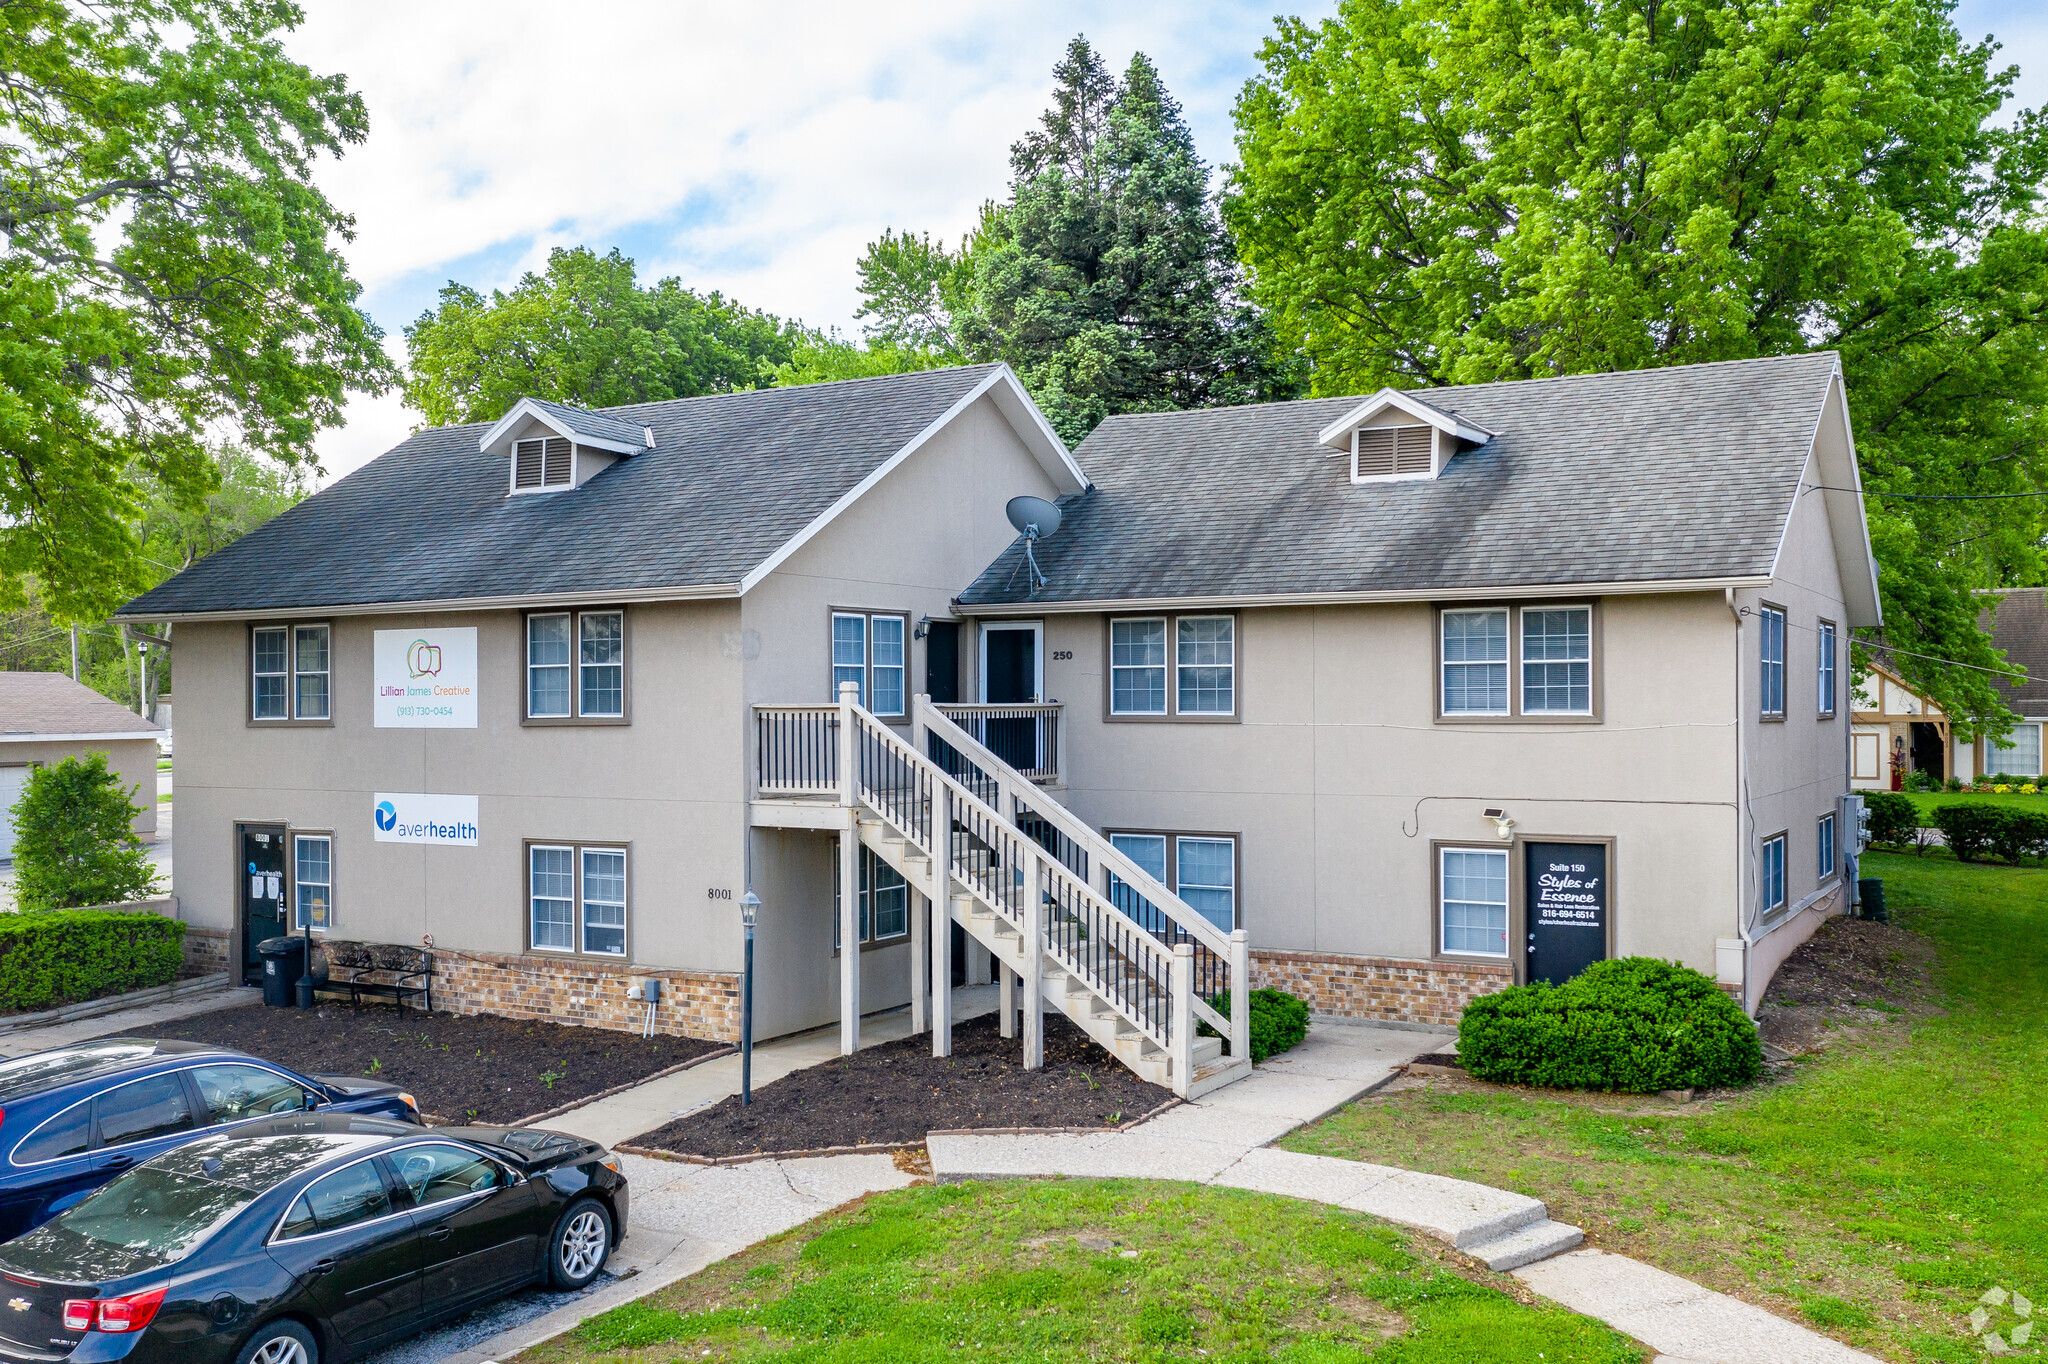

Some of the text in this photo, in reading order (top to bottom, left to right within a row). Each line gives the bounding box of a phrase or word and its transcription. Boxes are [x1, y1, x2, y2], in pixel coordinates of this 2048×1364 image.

[1052, 650, 1073, 661] 250
[380, 684, 471, 697] Lillian James Creative
[396, 704, 453, 718] (913) 730-0454
[398, 820, 477, 840] averhealth
[255, 869, 283, 878] averhealth
[1549, 863, 1586, 873] Suite 150
[1538, 873, 1599, 892] Styles of
[707, 887, 732, 900] 8001
[1540, 888, 1596, 903] Essence
[1542, 909, 1595, 919] 816-694-6514
